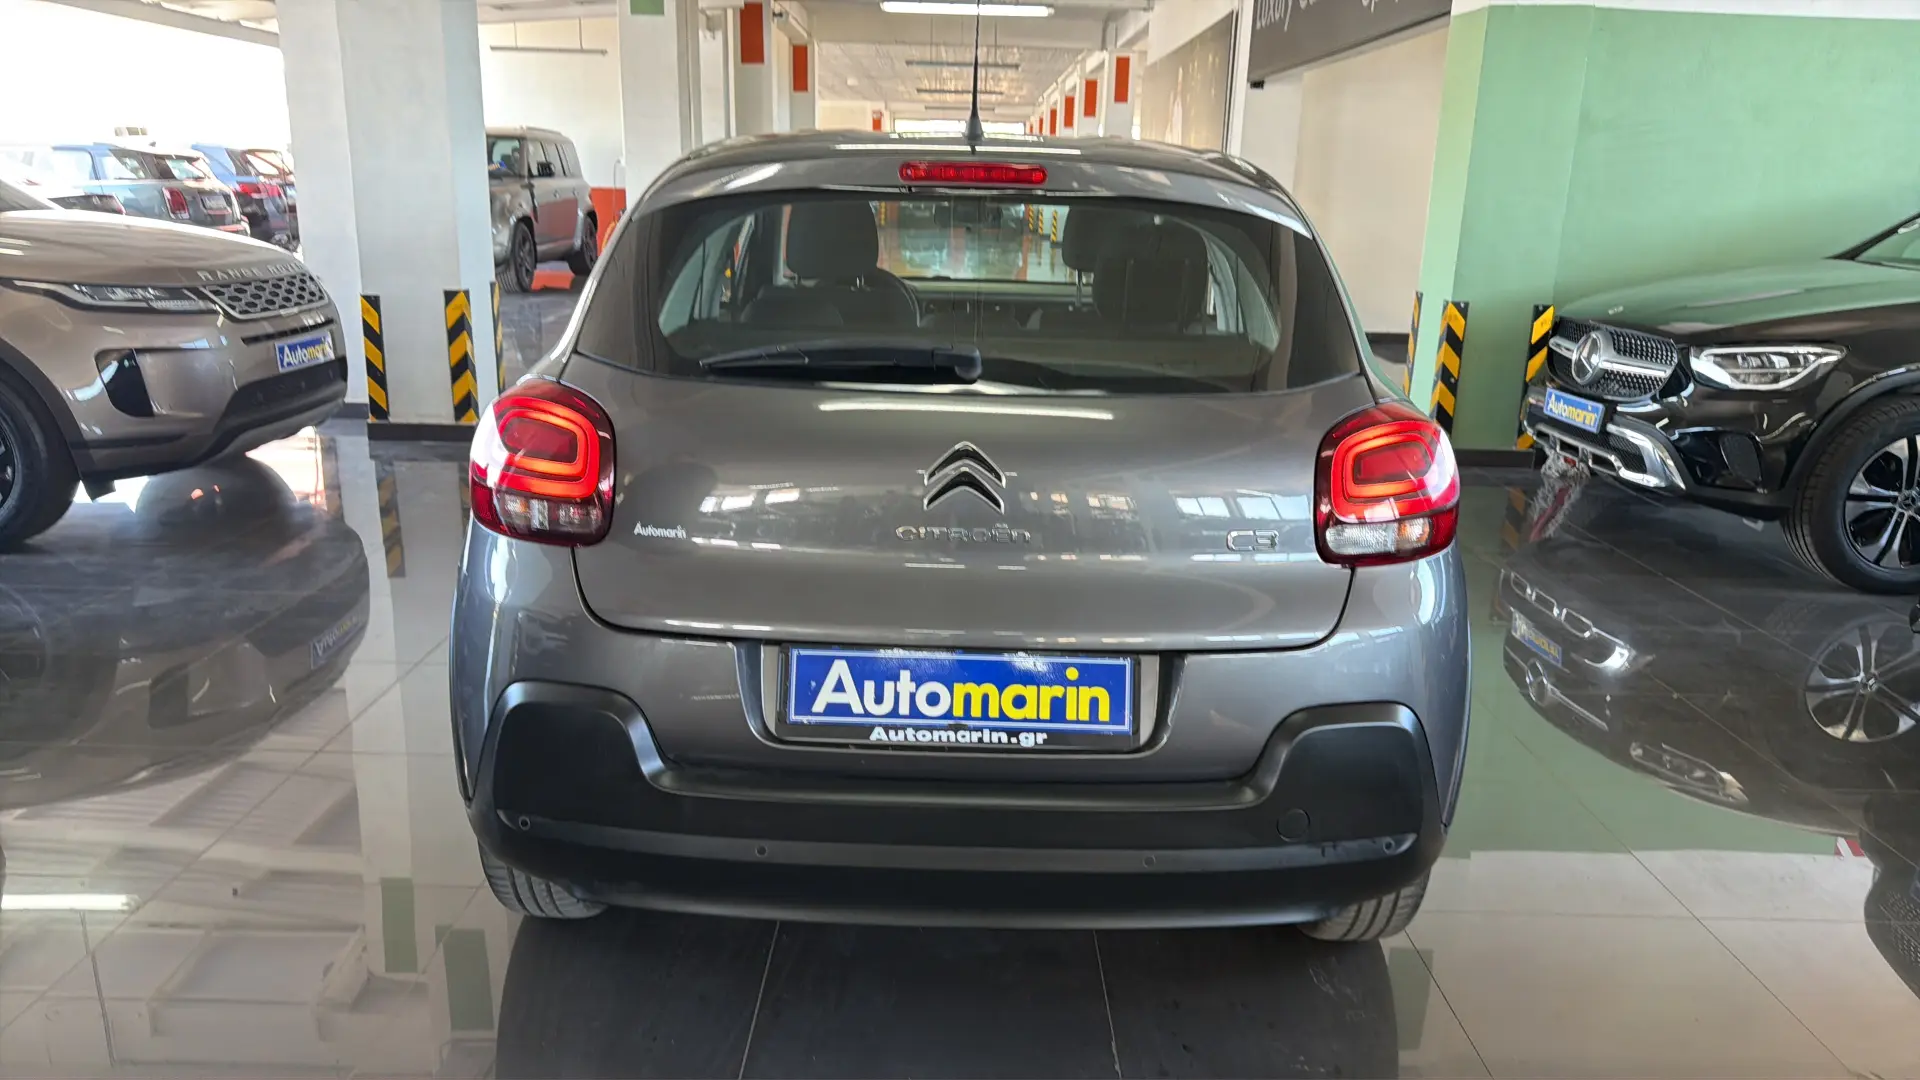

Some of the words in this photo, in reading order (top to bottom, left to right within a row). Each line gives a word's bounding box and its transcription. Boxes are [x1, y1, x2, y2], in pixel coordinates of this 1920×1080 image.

[196, 267, 263, 281] RANGE
[1548, 393, 1597, 427] Automarin
[633, 521, 687, 539] Automarin
[1227, 529, 1279, 551] C3
[811, 658, 1110, 721] Automarin
[869, 726, 1048, 748] Automarin.gr
